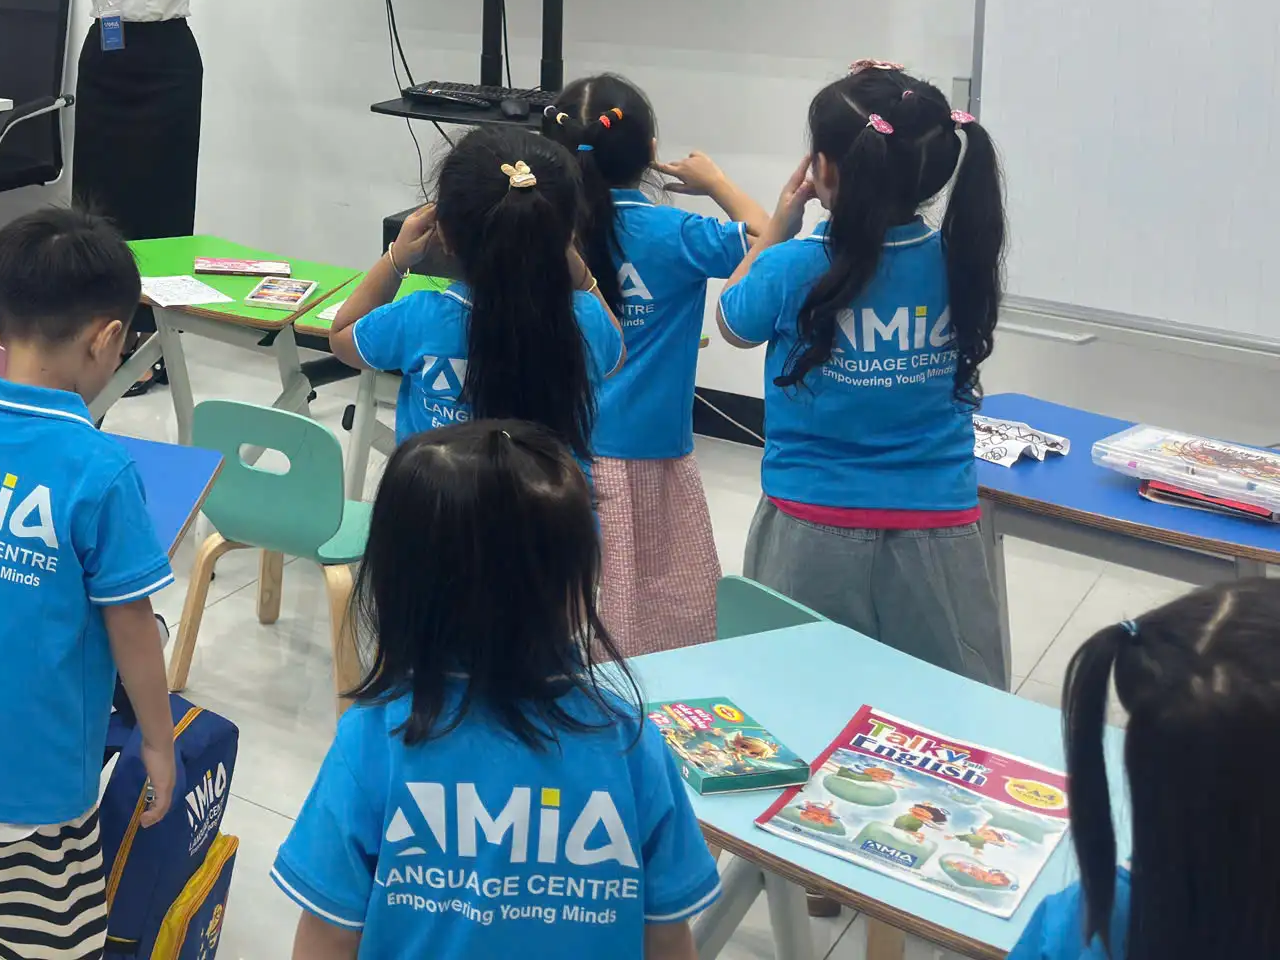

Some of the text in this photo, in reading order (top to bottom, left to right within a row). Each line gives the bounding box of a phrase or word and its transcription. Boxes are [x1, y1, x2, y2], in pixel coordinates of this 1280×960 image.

[616, 303, 654, 316] NTRE
[619, 318, 645, 327] inds
[829, 349, 958, 372] NGUAGE CENTR
[822, 366, 893, 387] Empowering
[895, 371, 926, 385] Young
[423, 398, 469, 423] LANG
[0, 566, 41, 587] Minds
[869, 719, 970, 765] Talky
[850, 733, 987, 786] English
[375, 866, 639, 900] LANGUAGE CENTRE
[387, 892, 617, 925] Empowering Young Minds
